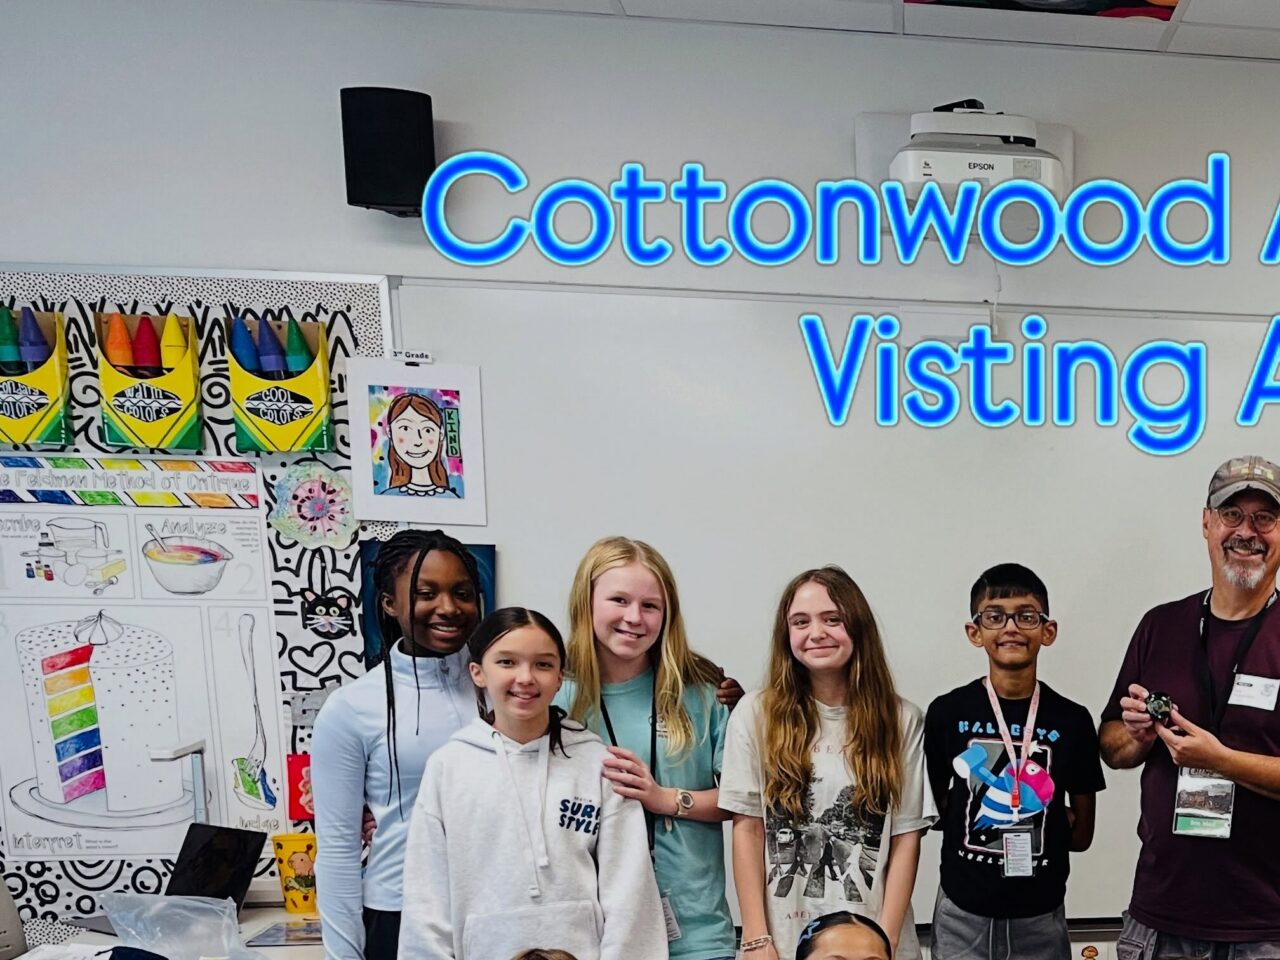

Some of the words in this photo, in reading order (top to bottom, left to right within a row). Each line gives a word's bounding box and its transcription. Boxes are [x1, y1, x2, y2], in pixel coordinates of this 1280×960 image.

[968, 162, 995, 171] EPSON
[405, 351, 429, 359] Grade
[447, 410, 458, 456] KIND
[161, 472, 181, 490] of
[0, 514, 41, 533] cribe
[161, 517, 227, 539] Analyze
[1010, 723, 1061, 743] GYS
